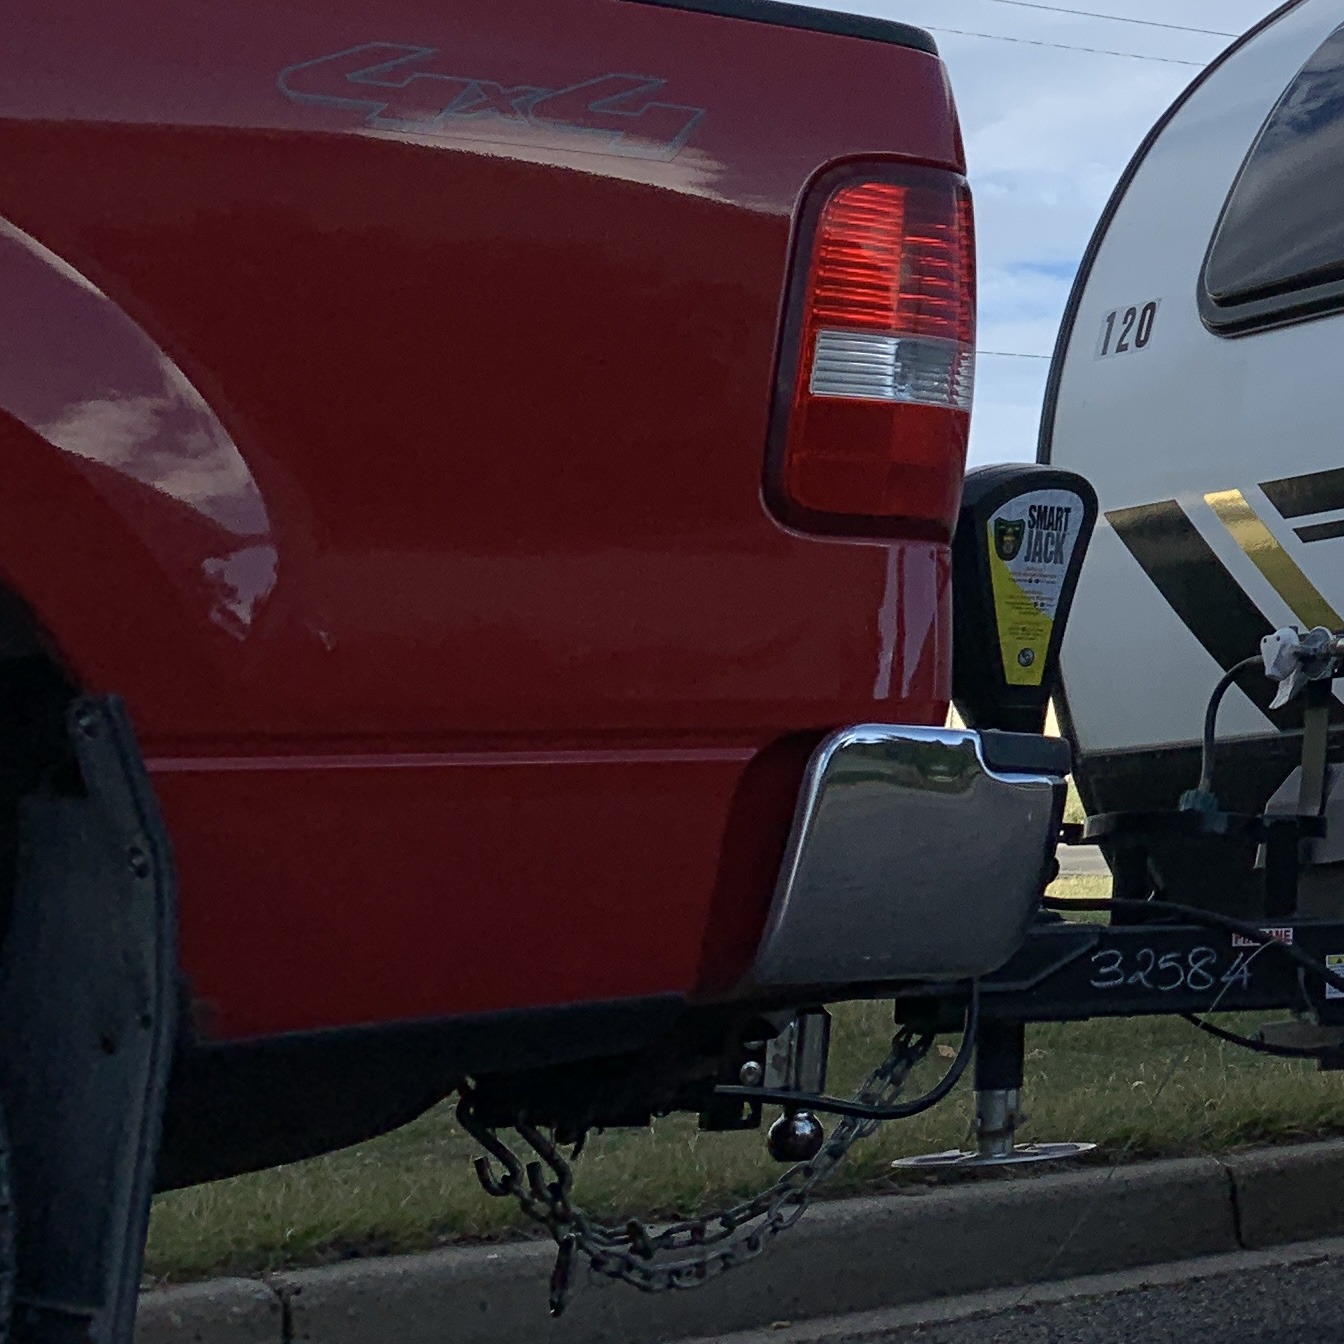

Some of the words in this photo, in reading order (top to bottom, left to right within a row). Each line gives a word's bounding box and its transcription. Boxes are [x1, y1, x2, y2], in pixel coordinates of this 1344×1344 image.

[1100, 301, 1157, 356] 120
[1028, 505, 1071, 531] SMART
[1024, 531, 1066, 564] JACK
[1090, 947, 1250, 991] 32584
